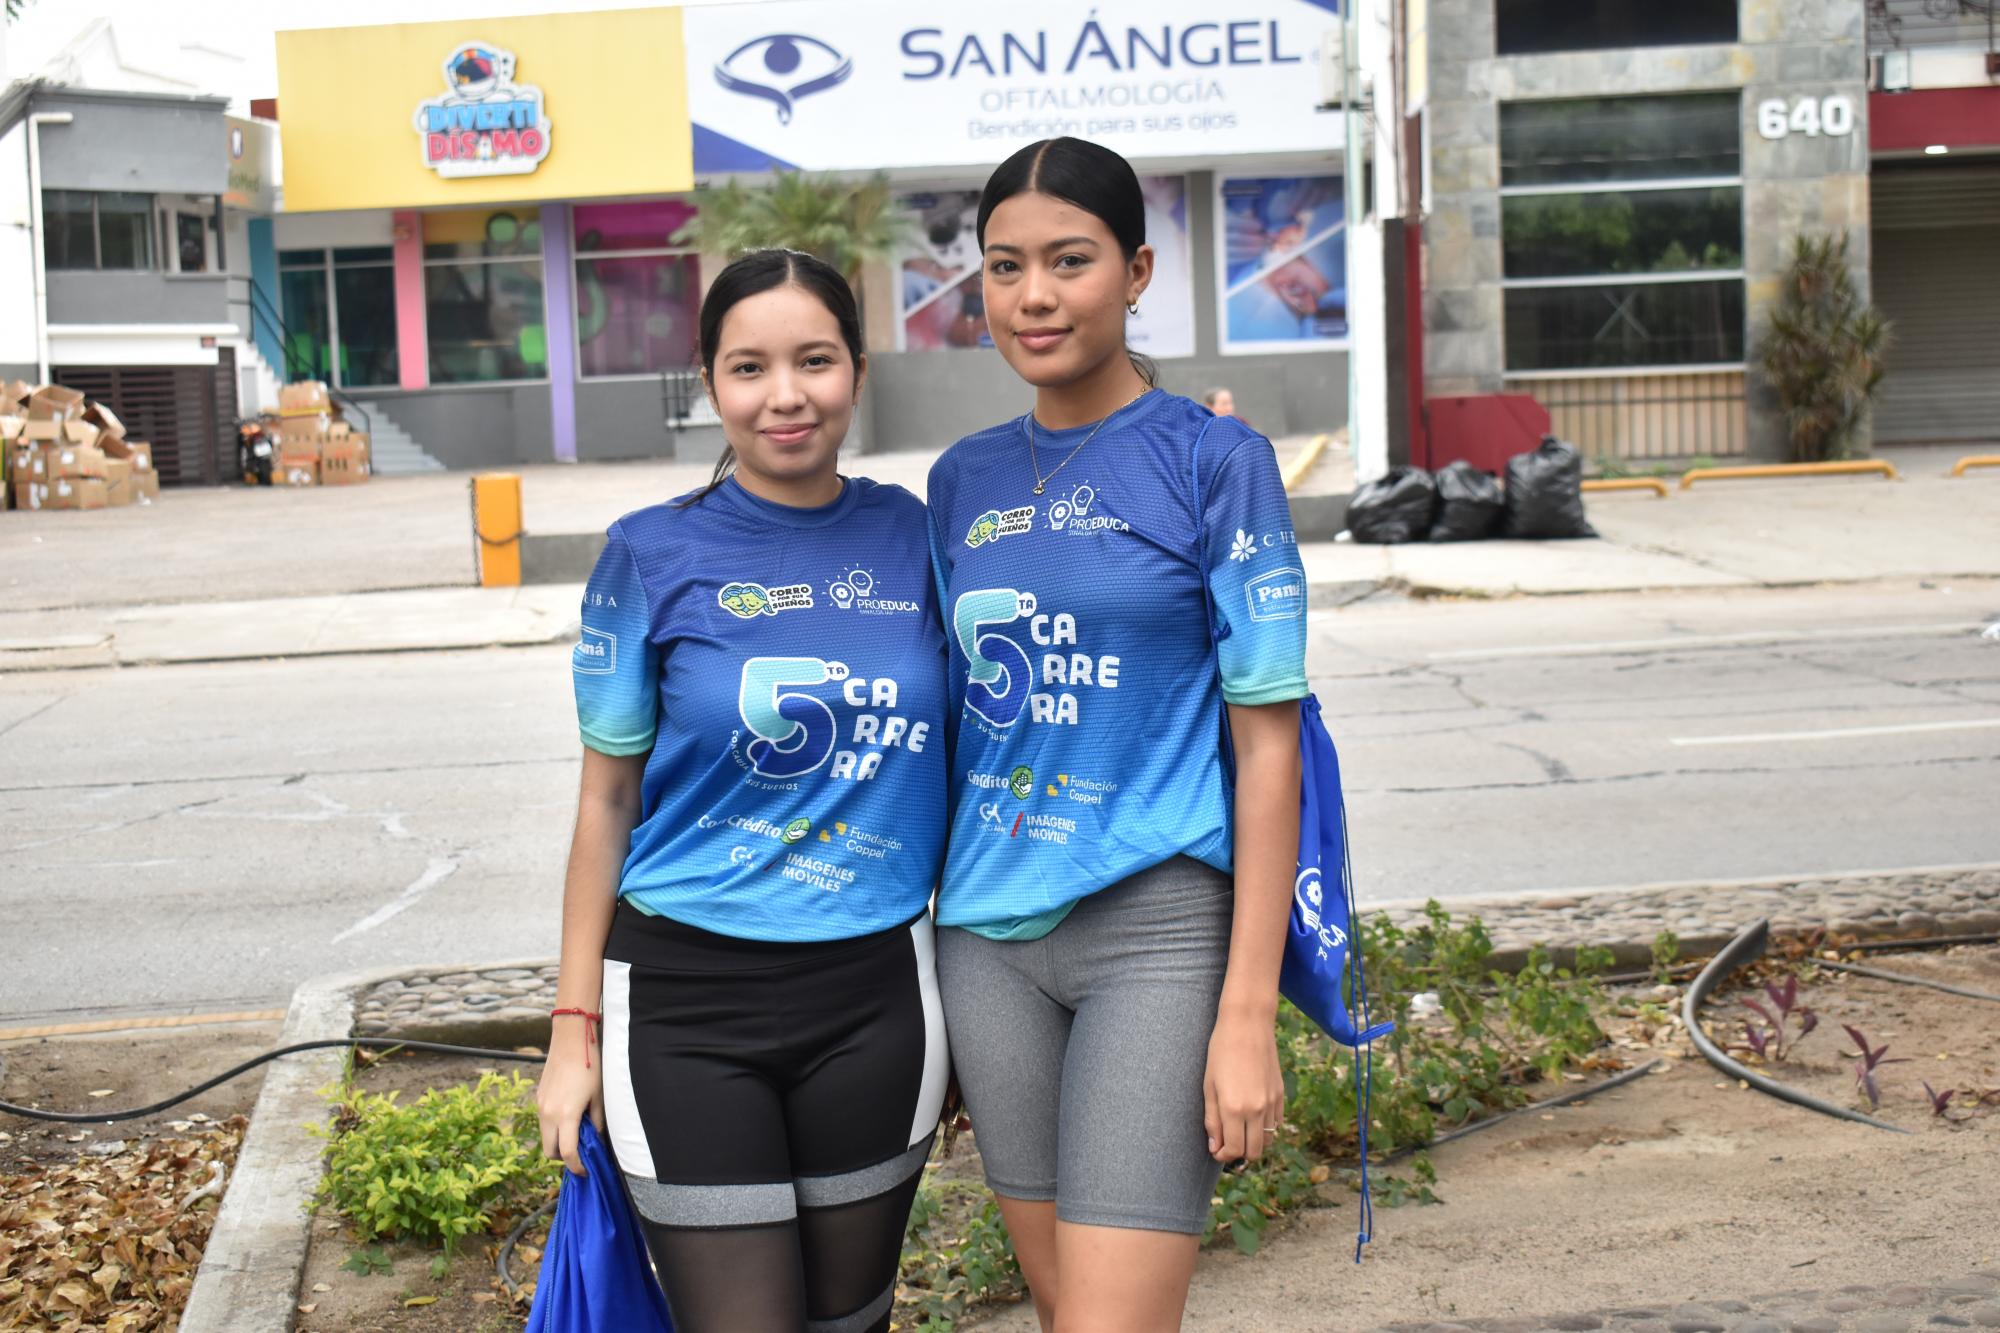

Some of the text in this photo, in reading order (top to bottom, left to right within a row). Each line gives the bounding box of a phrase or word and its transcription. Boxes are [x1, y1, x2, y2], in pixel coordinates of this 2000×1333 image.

[900, 8, 1302, 80] SAN ÁNGEL
[979, 77, 1226, 113] OFTALMOLOGÍA
[427, 101, 537, 131] DIVERTI
[967, 110, 1239, 140] Bendición para sus ojos
[1758, 96, 1853, 140] 640
[1002, 508, 1033, 521] CORRO
[1069, 516, 1129, 533] PROEDUCA
[769, 586, 809, 598] CORRO
[772, 599, 811, 609] SUEÑOS
[857, 599, 920, 612] PROEDUCA
[1030, 613, 1077, 646] CA
[1043, 653, 1121, 688] RRE
[843, 678, 898, 708] CA
[1030, 692, 1078, 725] RA
[852, 714, 930, 753] RRE
[829, 751, 884, 781] RA
[1069, 788, 1102, 805] Coppel
[1070, 775, 1118, 792] Fundación
[845, 839, 886, 859] Coppel
[850, 825, 902, 850] Fundación
